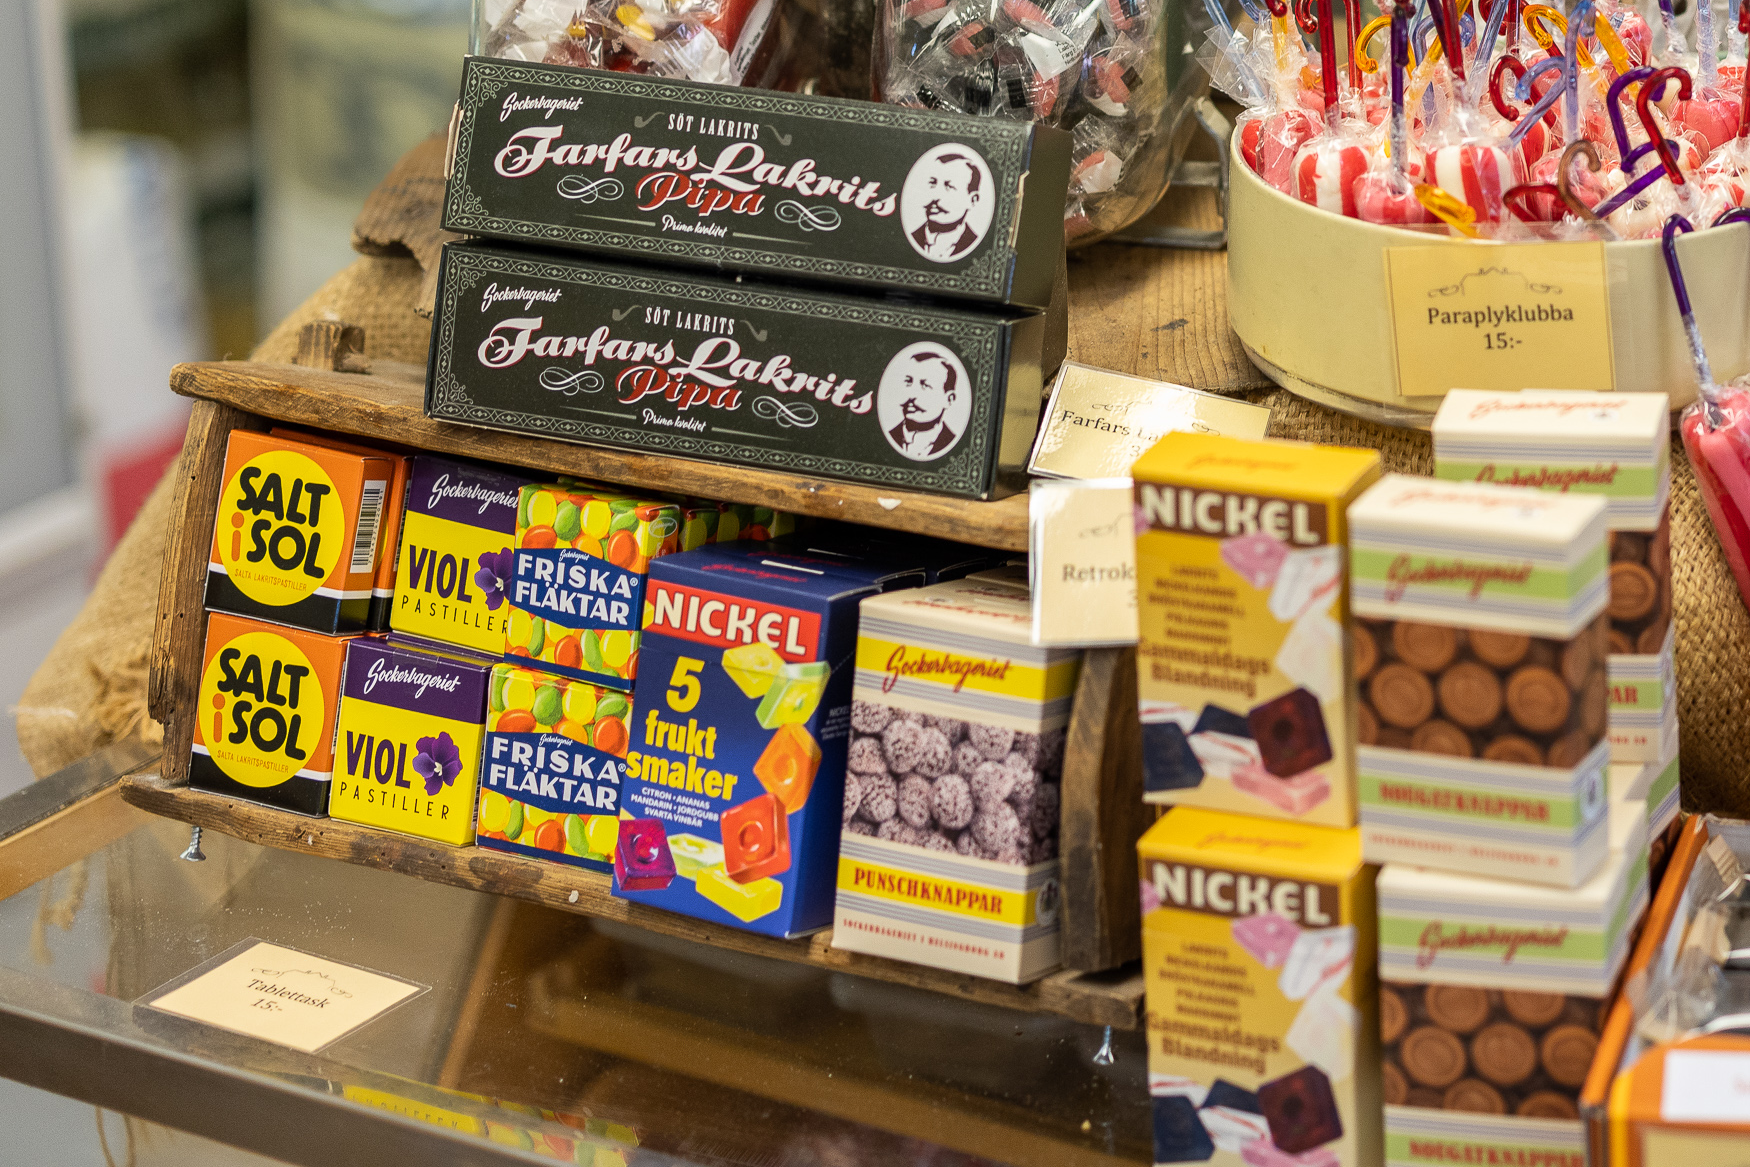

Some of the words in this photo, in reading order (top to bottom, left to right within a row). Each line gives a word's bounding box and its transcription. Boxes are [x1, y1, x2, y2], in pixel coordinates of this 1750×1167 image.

[500, 91, 584, 122] Sockerbageriet
[668, 113, 695, 132] SÖT
[700, 117, 761, 140] LAKRITS
[494, 125, 699, 178] Farfars
[690, 142, 897, 217] Lakrits
[635, 171, 766, 217] Pipa
[662, 214, 694, 233] Prima
[694, 221, 728, 238] kvalitet
[481, 282, 563, 312] Sockerbageriet
[1427, 304, 1575, 329] Paraplyklubba
[645, 306, 671, 325] SÖT
[676, 311, 735, 335] LAKRITS
[1483, 332, 1523, 350] 15:-
[477, 316, 676, 369] Farfars
[668, 337, 873, 415] Lakrits
[615, 365, 742, 411] Pipa
[643, 408, 674, 426] Prima
[674, 415, 707, 432] kvalitet
[1061, 409, 1130, 437] Farfars
[236, 466, 331, 529] SALT
[1140, 483, 1321, 545] NICKEL
[230, 512, 245, 563] i
[246, 525, 325, 579] SOL
[234, 568, 252, 580] SALTA
[253, 572, 307, 592] LAKRITSPASTILLER
[408, 544, 473, 603] VIOL
[401, 594, 508, 634] PASTILLER
[515, 581, 630, 626] FLÄKTAR
[653, 588, 807, 656] NICKEL
[217, 647, 310, 710] SALT
[363, 658, 461, 698] Sockerbageriet
[665, 655, 705, 713] 5
[882, 644, 1014, 694] Sockerbageriet
[212, 693, 226, 743] i
[228, 700, 307, 761] SOL
[645, 709, 717, 760] frukt
[217, 749, 234, 762] SALTA
[236, 752, 289, 774] LAKRITSPASTILLER
[346, 731, 411, 790] VIOL
[626, 751, 738, 801] smaker
[340, 781, 450, 820] PASTILLER
[489, 763, 618, 811] FLÄKTAR
[630, 793, 673, 811] MANDARIN
[641, 786, 672, 801] CITRON
[675, 795, 710, 810] ANANAS
[644, 806, 673, 820] SVARTA
[673, 813, 703, 828] VINBÄR
[854, 866, 1003, 915] PUNSCHKNAPPAR
[1153, 862, 1333, 926] NICKEL
[247, 978, 331, 1010] Tablettask
[250, 997, 284, 1013] 15:-
